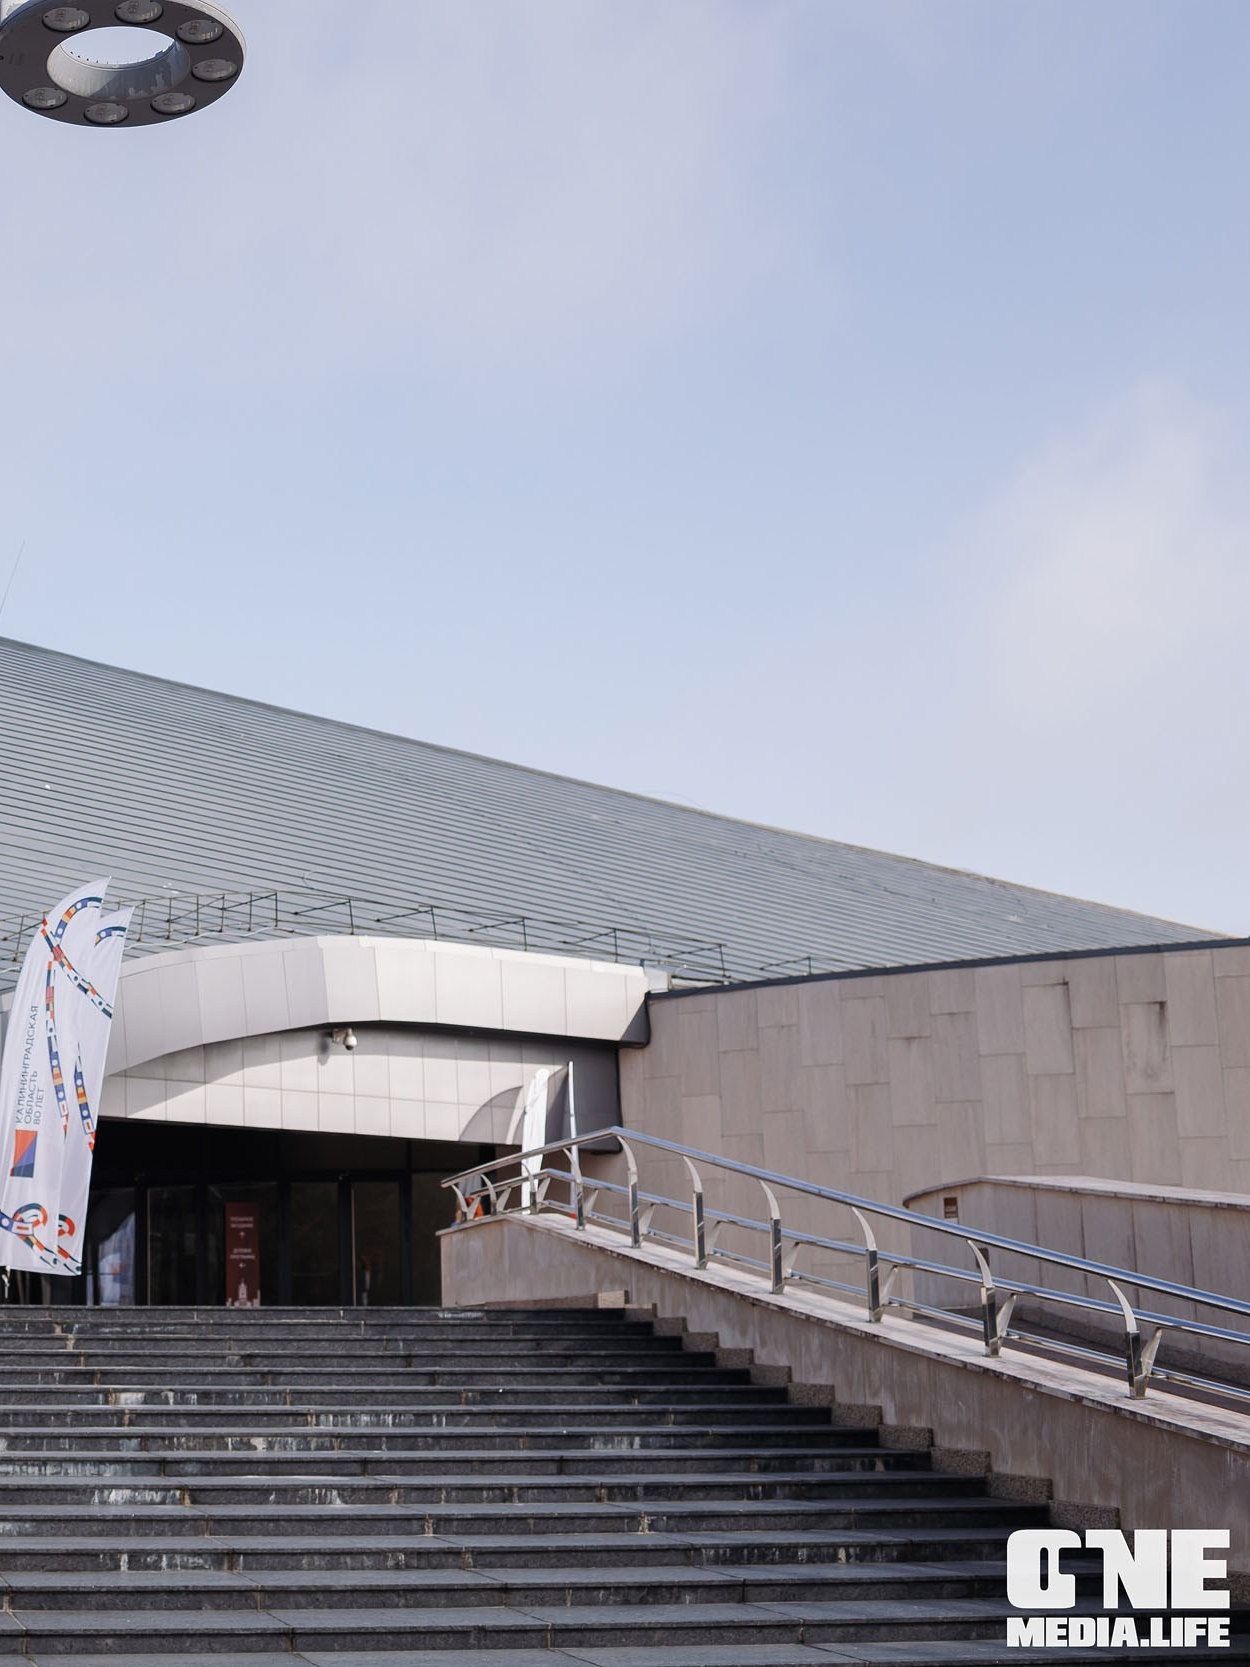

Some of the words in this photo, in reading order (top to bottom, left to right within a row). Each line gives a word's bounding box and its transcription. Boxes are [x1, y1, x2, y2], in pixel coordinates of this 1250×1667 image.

[15, 1005, 39, 1124] КАЛИНИНГРАДСКАЯ
[24, 1070, 38, 1125] ОБЛАСТЬ
[34, 1088, 45, 1110] ЛЕТ
[33, 1111, 42, 1125] 80
